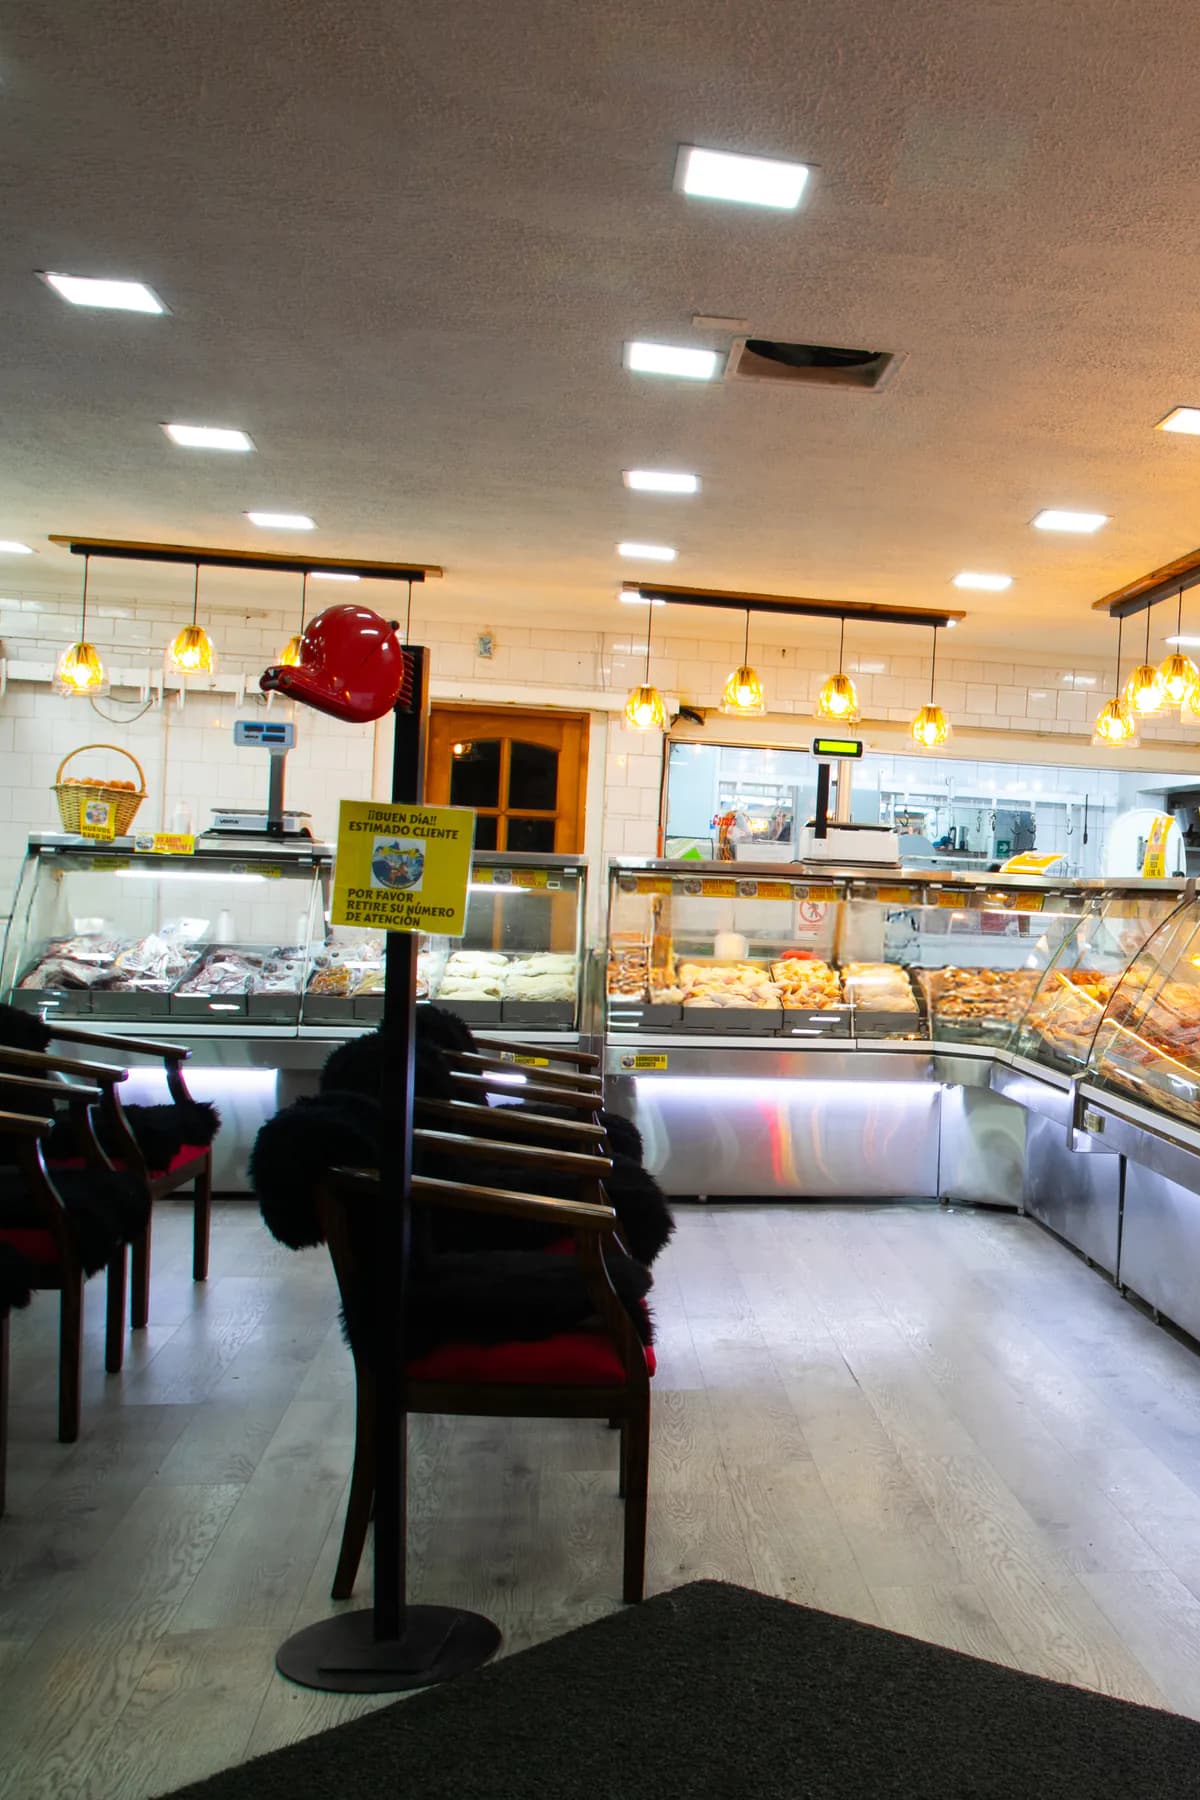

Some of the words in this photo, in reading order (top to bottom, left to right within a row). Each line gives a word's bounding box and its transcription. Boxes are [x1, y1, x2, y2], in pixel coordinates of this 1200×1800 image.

[349, 821, 410, 836] ESTIMADO
[413, 826, 459, 840] CLIENTE
[348, 888, 373, 899] POR
[376, 890, 414, 902] FAVOR
[347, 900, 387, 913] RETIRE
[390, 903, 404, 914] SU
[407, 901, 455, 918] NÚMERO
[346, 911, 361, 922] DE
[363, 911, 420, 926] ATENCIÓN
